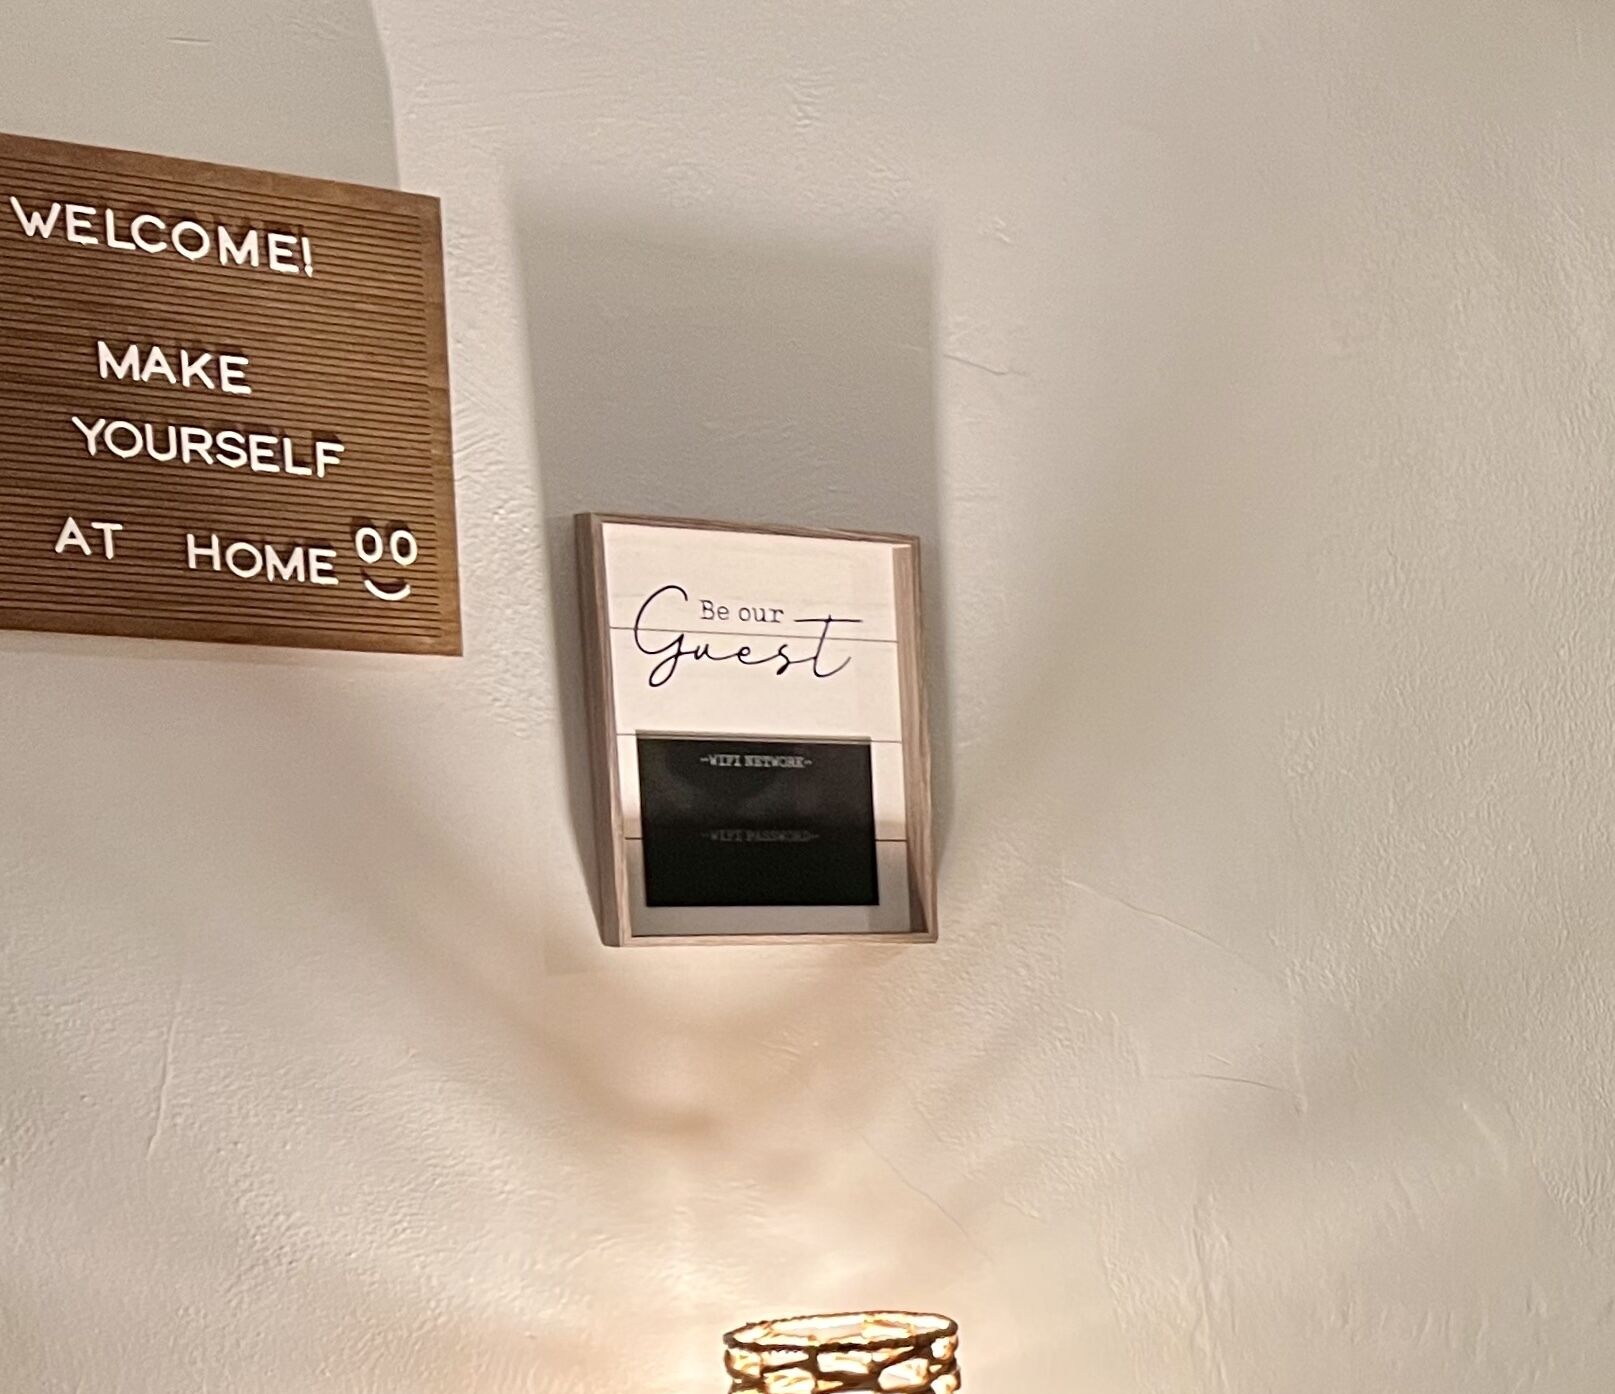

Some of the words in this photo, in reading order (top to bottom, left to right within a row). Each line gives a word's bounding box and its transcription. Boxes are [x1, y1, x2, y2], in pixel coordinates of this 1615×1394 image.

[10, 196, 314, 278] WELCOME!
[97, 341, 252, 395] MAKE
[71, 416, 345, 478] YOURSELF
[55, 517, 123, 560] AT
[186, 533, 339, 585] HOME
[633, 585, 863, 688] Guest
[700, 599, 729, 621] Be
[738, 607, 785, 624] our
